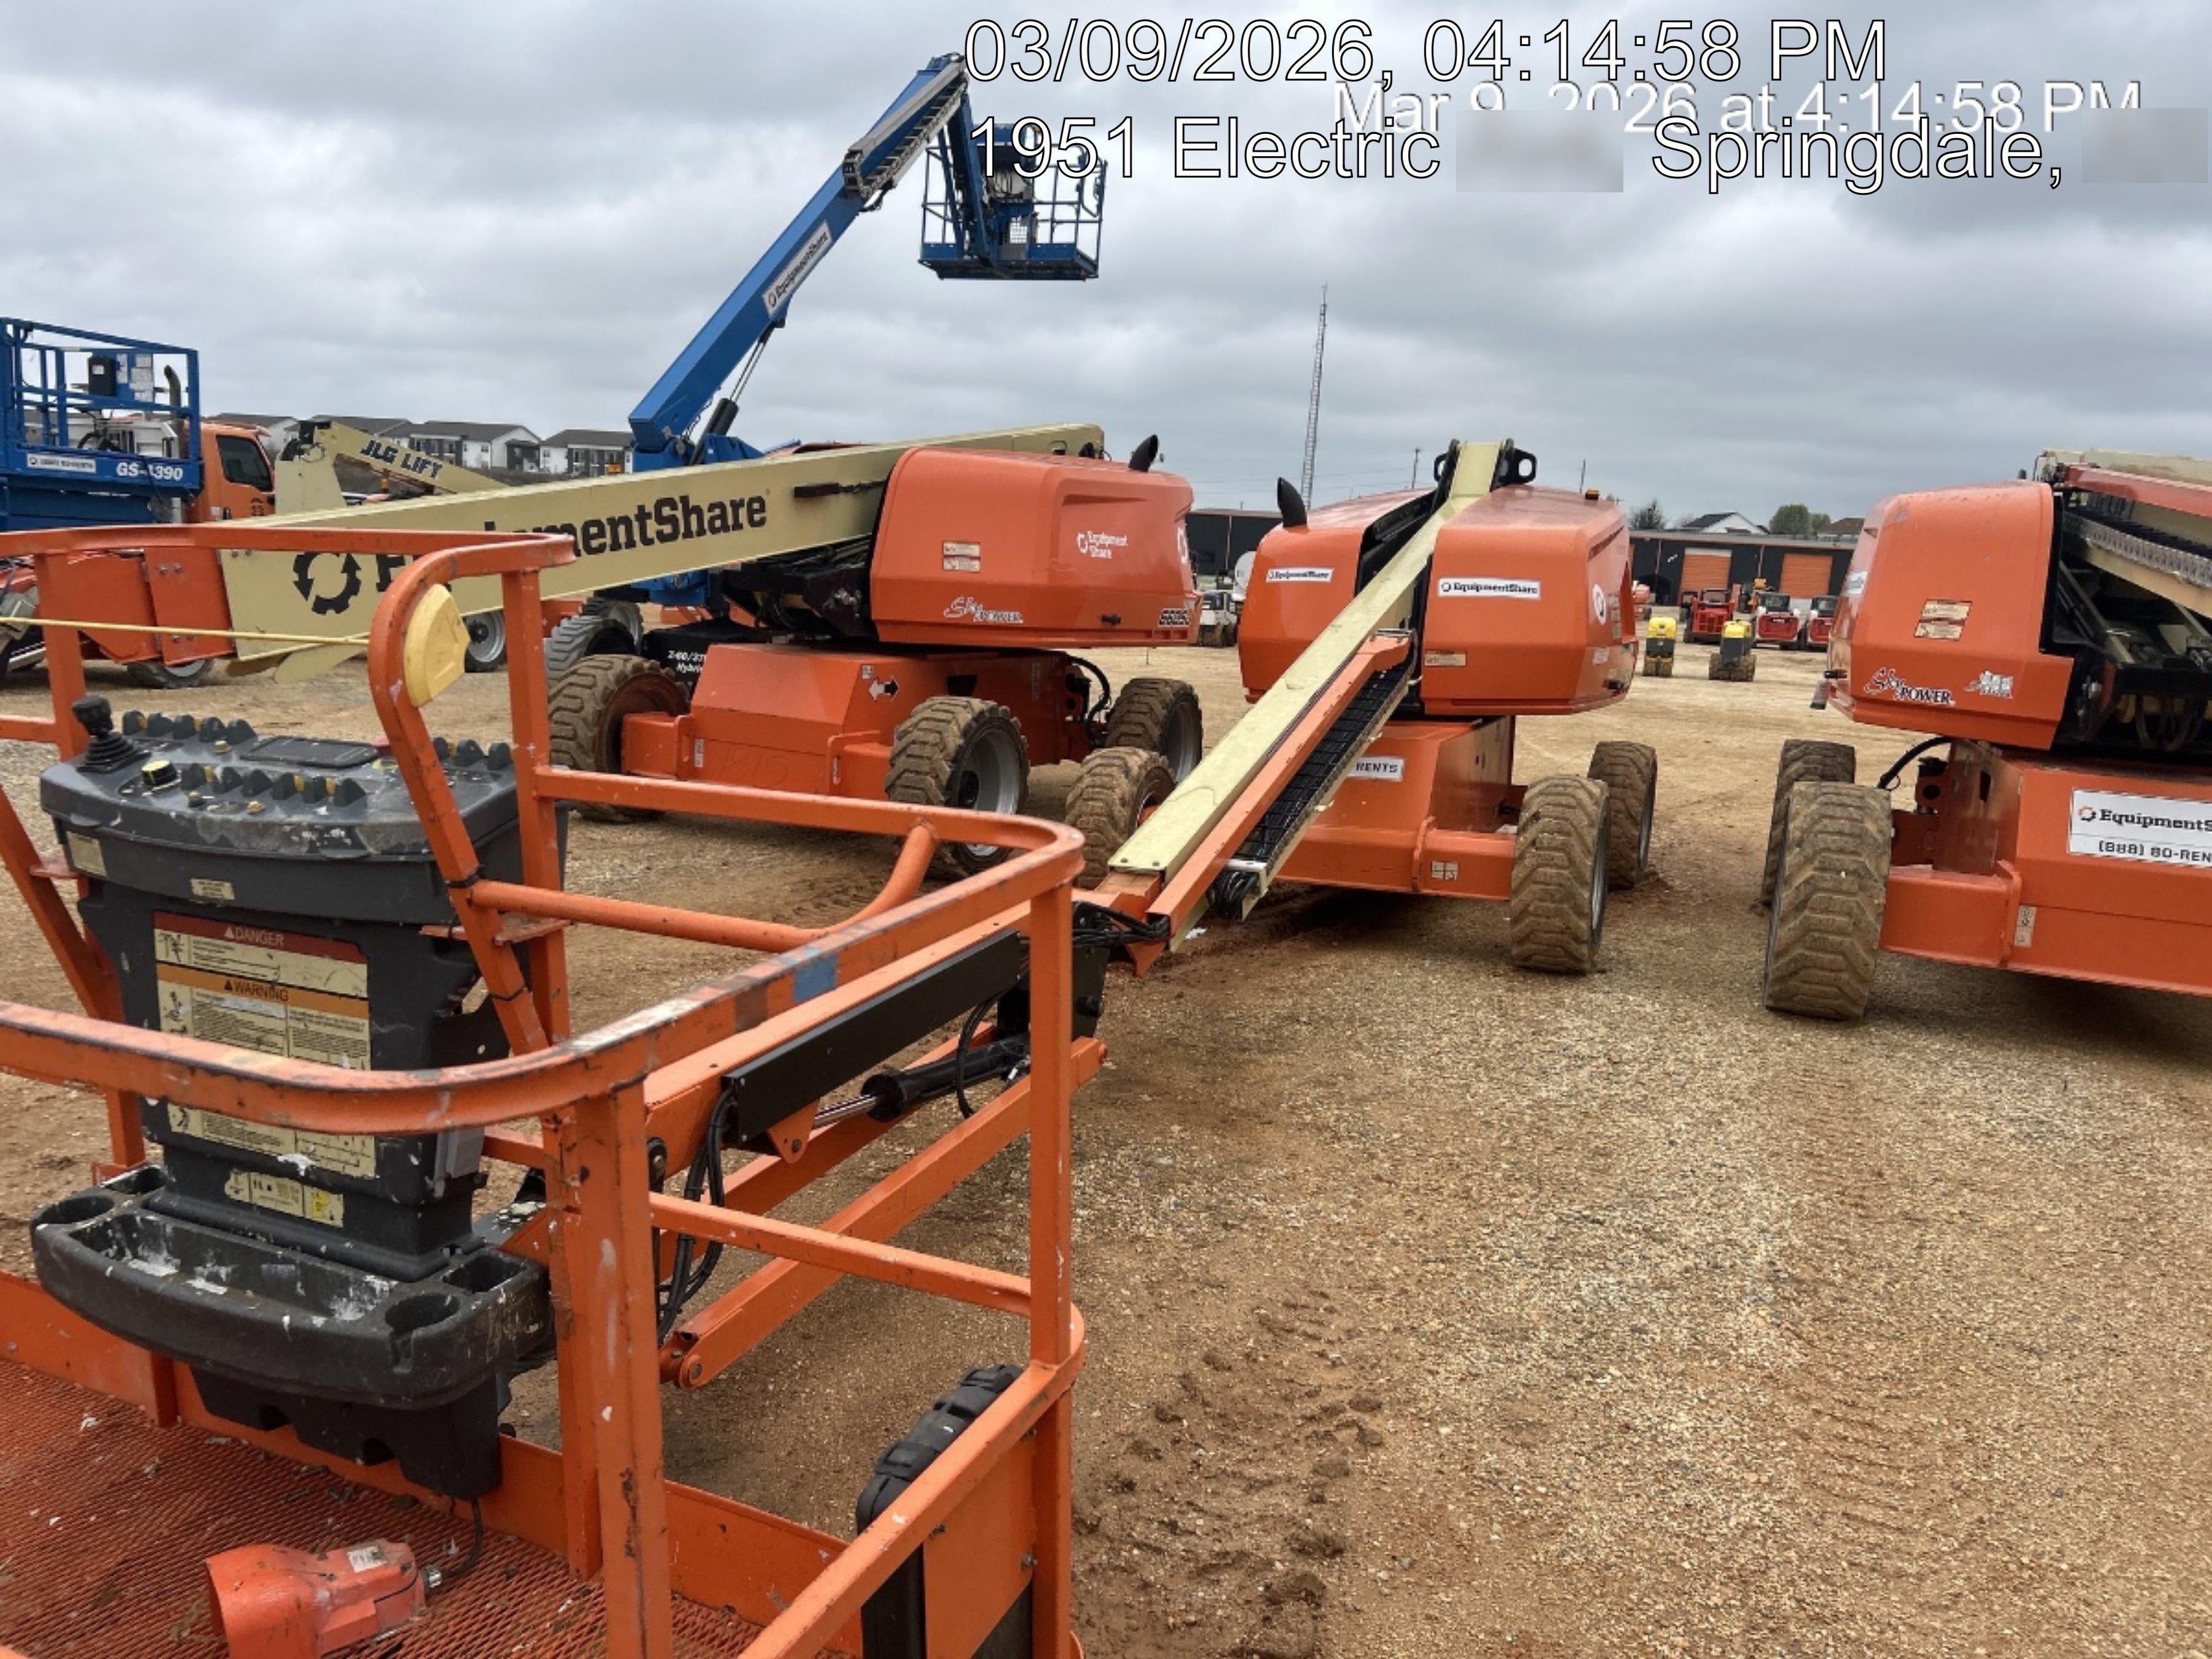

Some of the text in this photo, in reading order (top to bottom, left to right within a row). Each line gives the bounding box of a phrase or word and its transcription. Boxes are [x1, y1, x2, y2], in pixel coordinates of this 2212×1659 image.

[359, 440, 442, 479] JLG LIFT
[1454, 582, 1538, 594] EquipmentShare
[1900, 686, 1954, 705] POWER
[2099, 840, 2144, 856] (888)
[235, 927, 284, 946] DANGER
[233, 979, 289, 1002] WARNING
